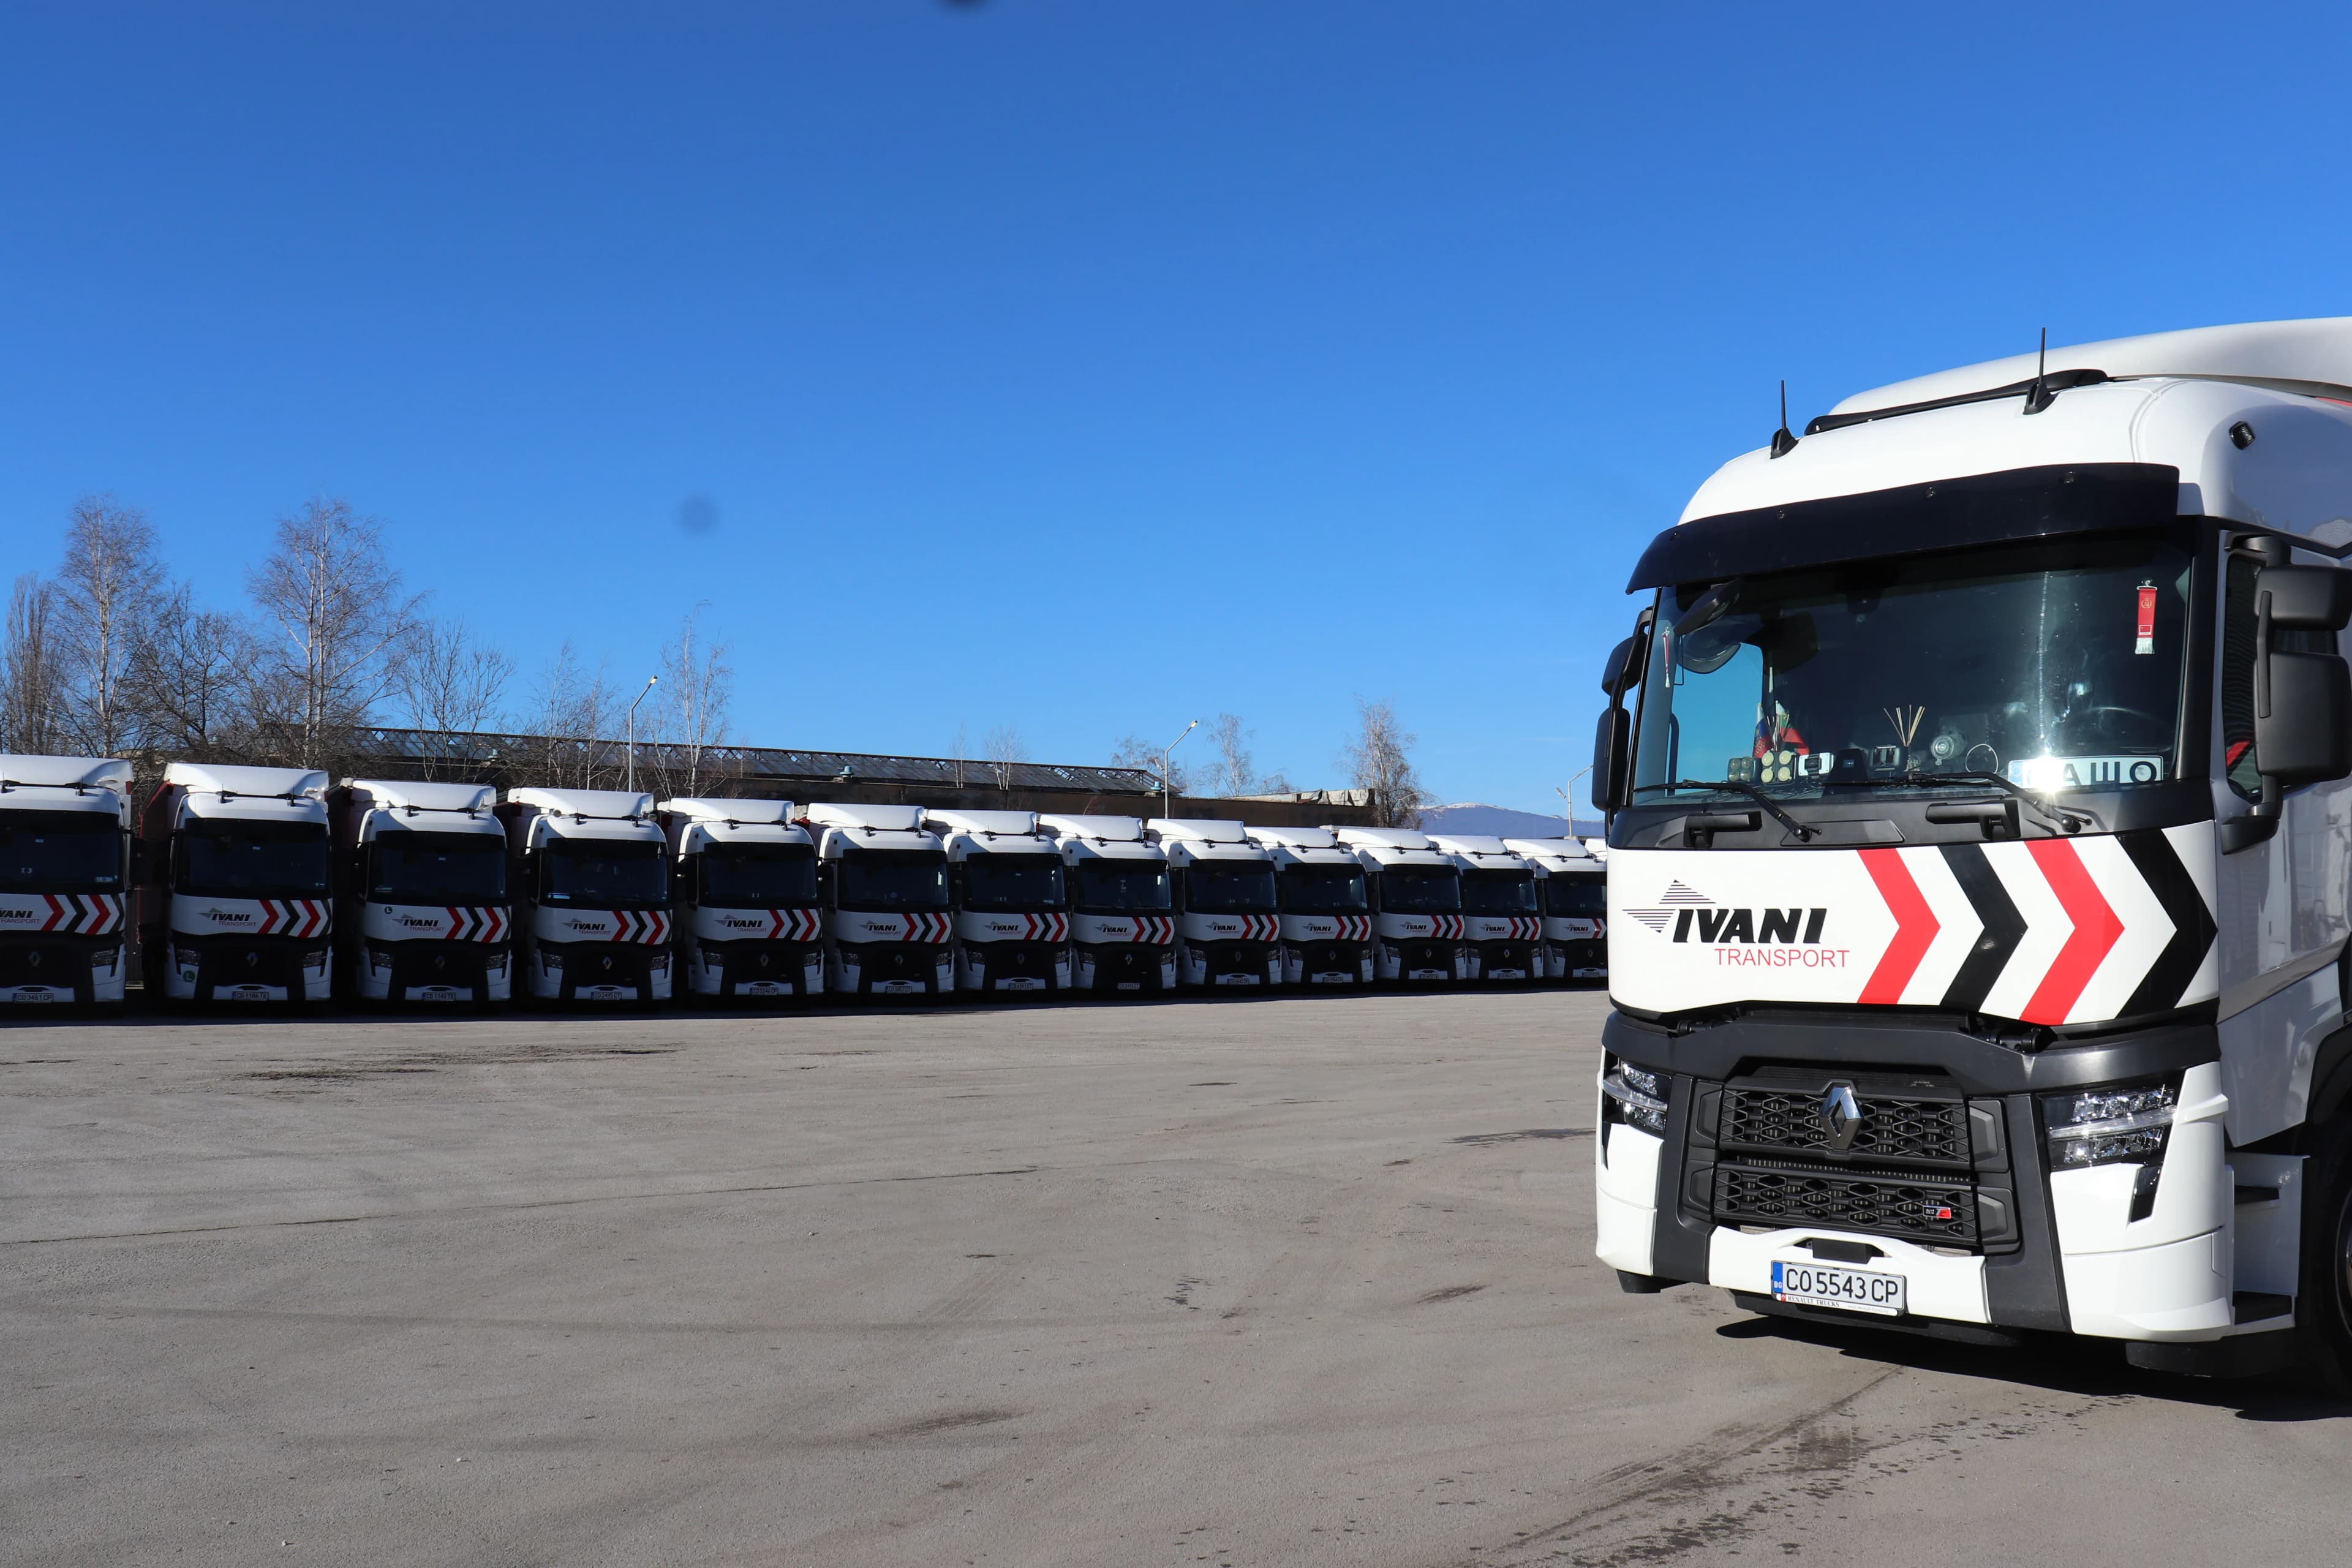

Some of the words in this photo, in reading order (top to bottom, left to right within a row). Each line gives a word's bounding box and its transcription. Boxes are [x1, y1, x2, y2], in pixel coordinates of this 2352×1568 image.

[2027, 761, 2157, 786] АШО
[1672, 908, 1827, 944] IVANI
[1714, 948, 1850, 968] TRANSPORT
[1774, 1281, 1782, 1289] BG
[1786, 1268, 1812, 1292] CO
[1816, 1272, 1866, 1300] 5543
[1871, 1279, 1898, 1303] CP
[1788, 1295, 1815, 1305] RENAULT
[1816, 1298, 1840, 1308] TRUCKS
